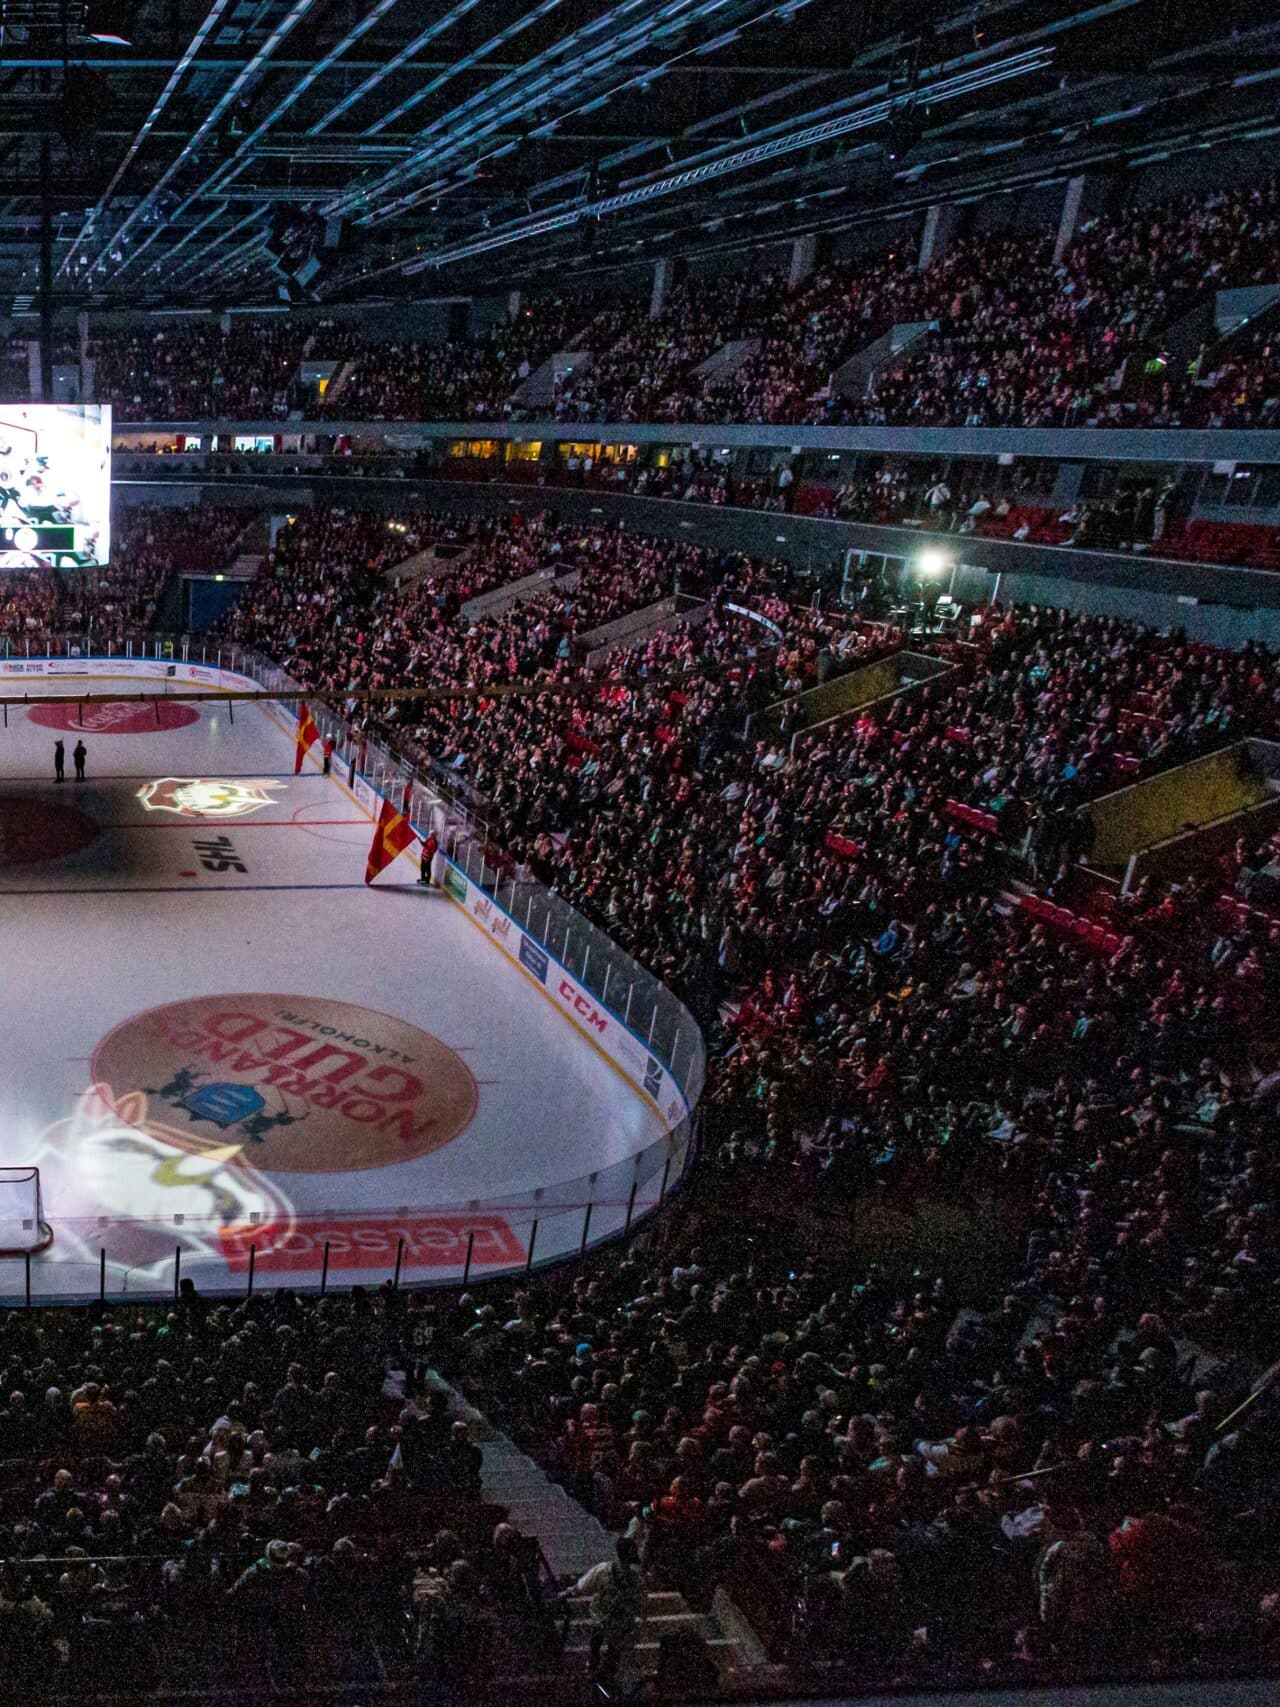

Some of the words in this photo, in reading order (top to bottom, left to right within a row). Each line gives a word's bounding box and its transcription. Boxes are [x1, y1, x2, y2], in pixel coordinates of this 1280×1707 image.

[192, 835, 249, 874] SHL
[558, 979, 609, 1034] CCM
[203, 1012, 424, 1104] GULD
